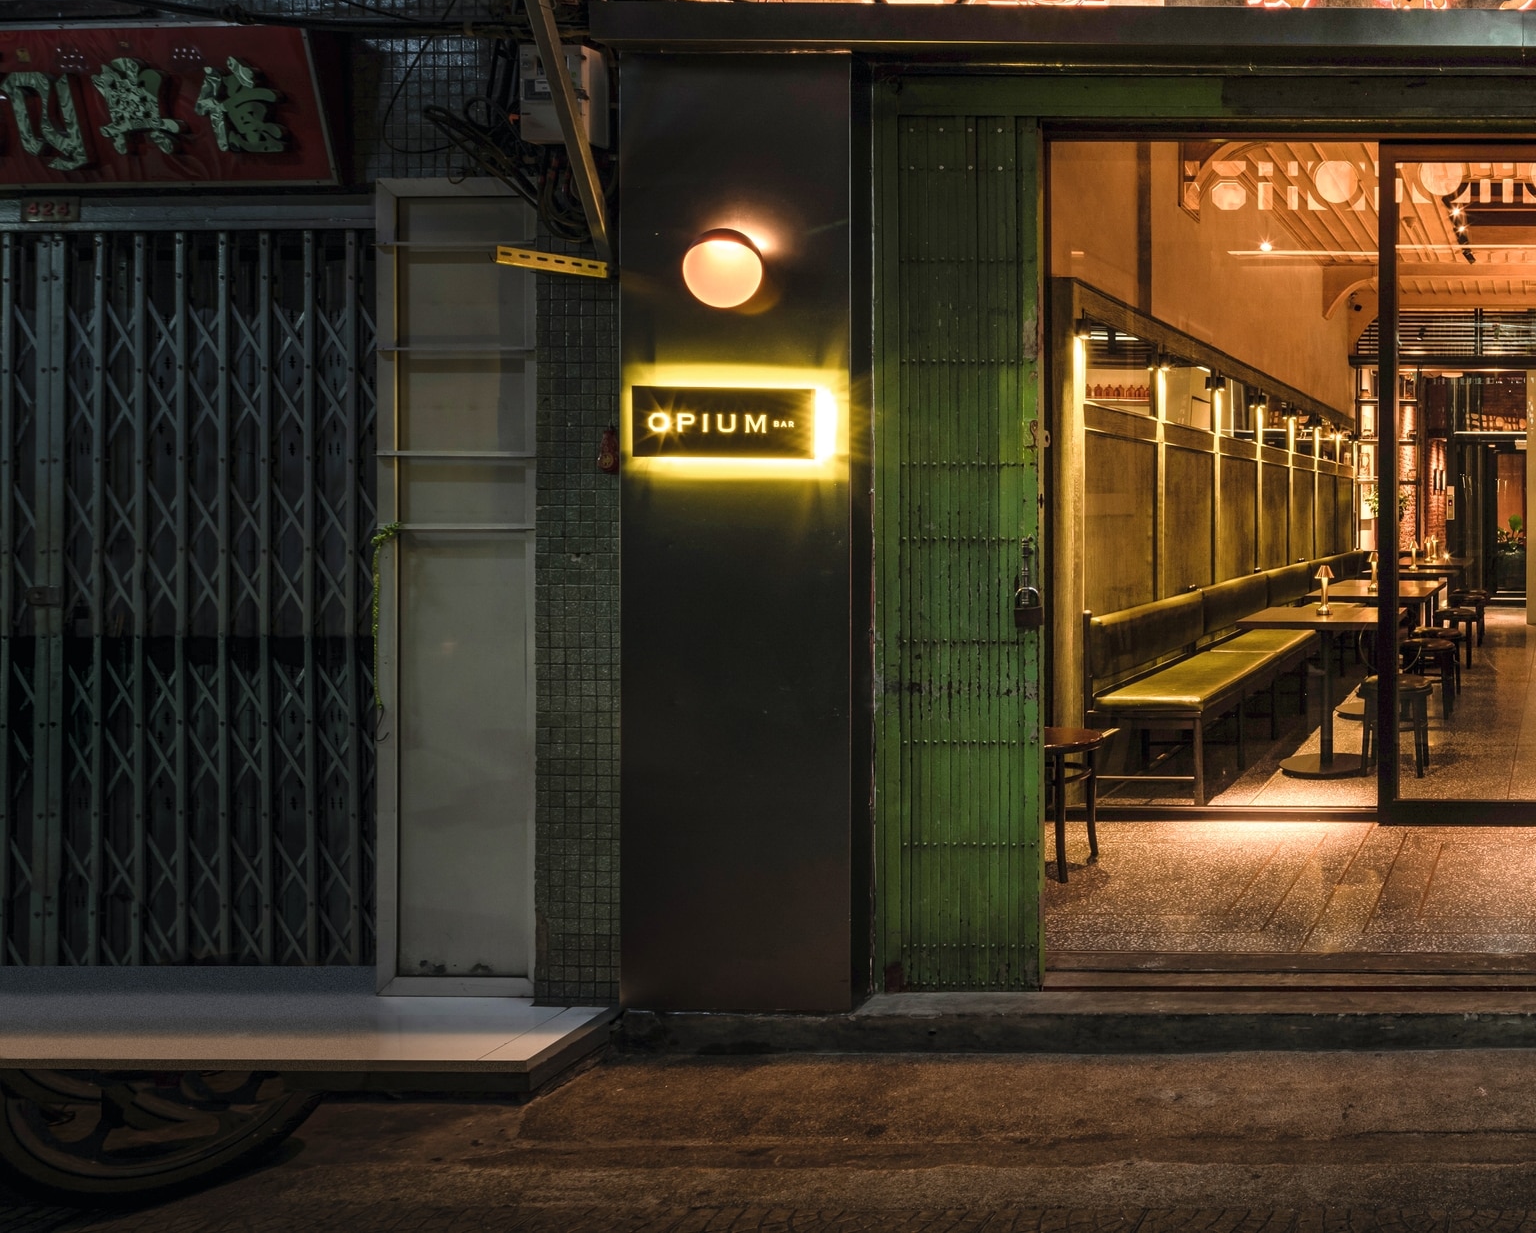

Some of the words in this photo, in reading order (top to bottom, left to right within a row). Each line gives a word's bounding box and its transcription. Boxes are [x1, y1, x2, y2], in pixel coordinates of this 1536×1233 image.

[27, 201, 70, 217] 424
[647, 412, 767, 434] OPIUM
[773, 420, 795, 428] BAR
